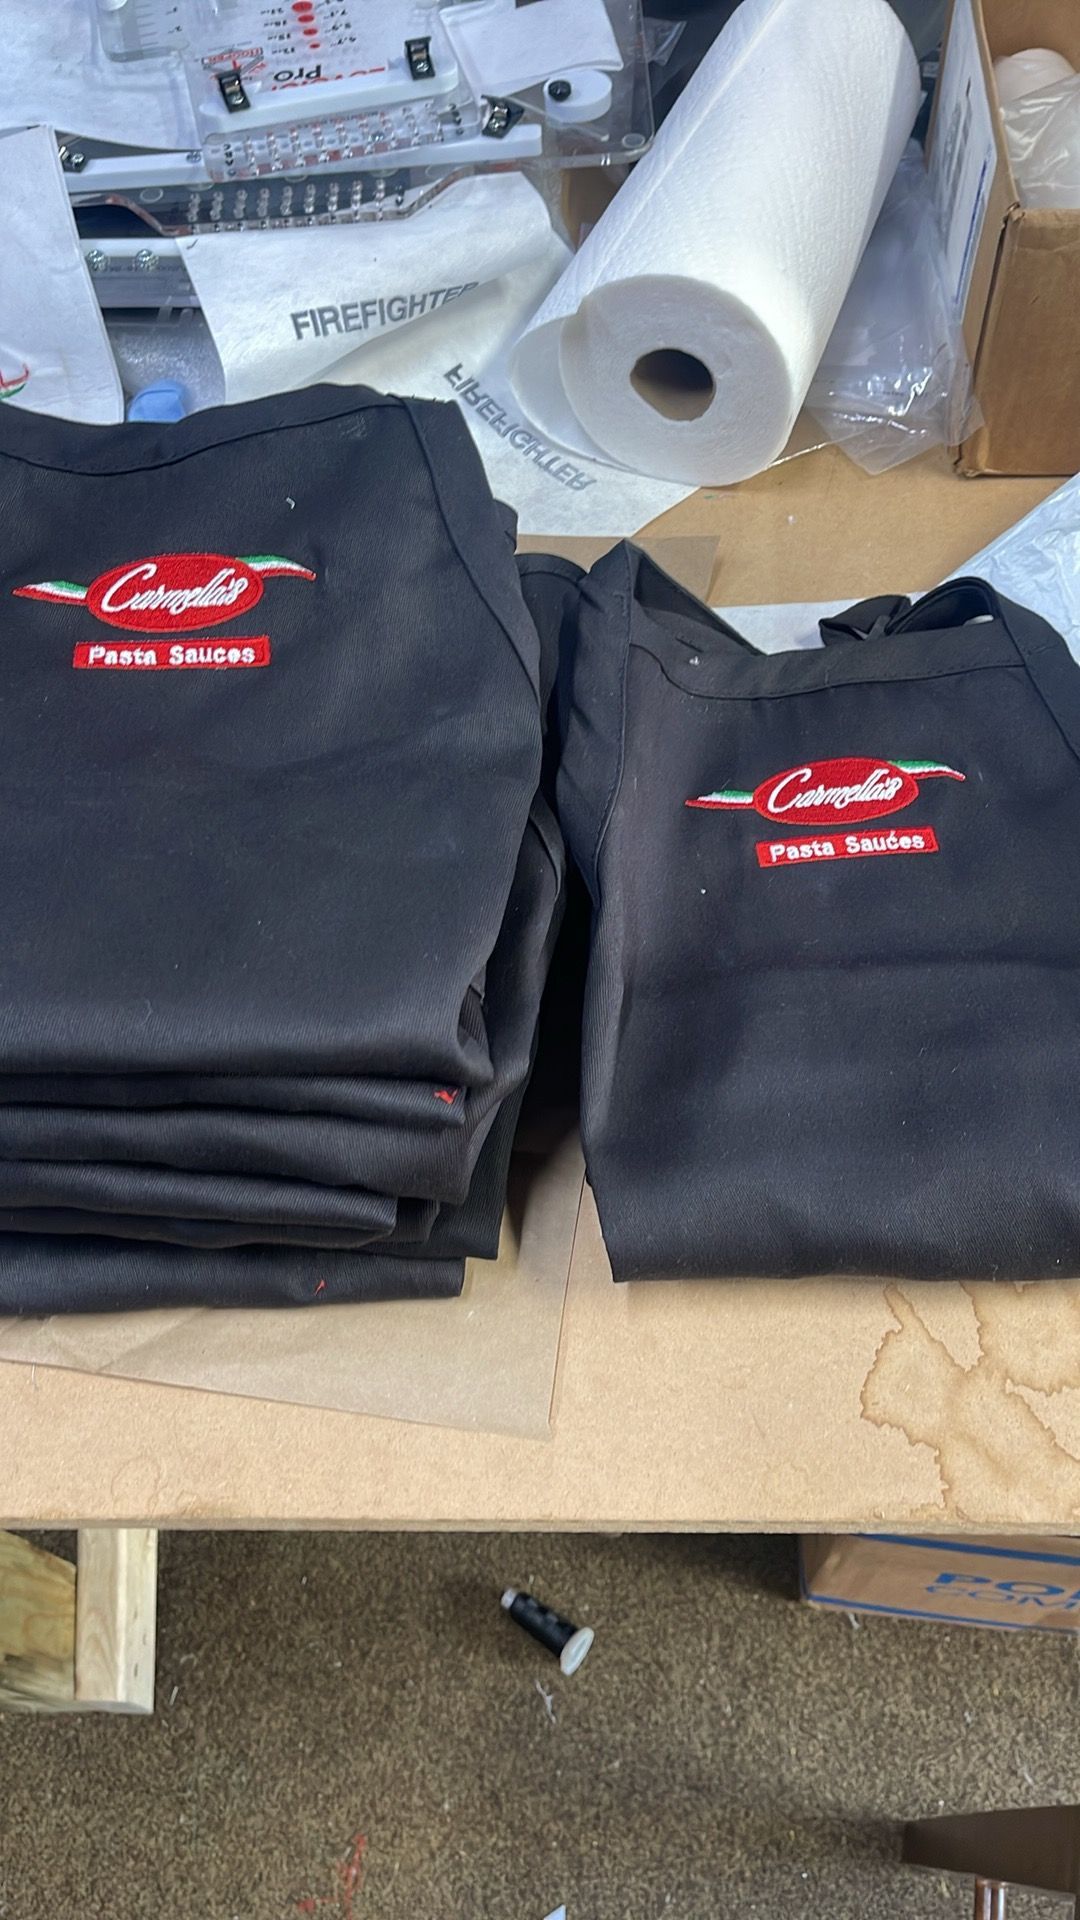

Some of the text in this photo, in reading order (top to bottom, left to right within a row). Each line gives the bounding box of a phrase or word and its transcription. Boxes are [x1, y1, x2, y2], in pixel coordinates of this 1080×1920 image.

[273, 64, 321, 82] Pro
[291, 281, 481, 341] FIREFIGHTER
[88, 645, 256, 666] Pasta Sauces
[767, 767, 904, 814] Carmella's
[769, 831, 926, 863] Pasta Sauces
[934, 1572, 1080, 1600] PO
